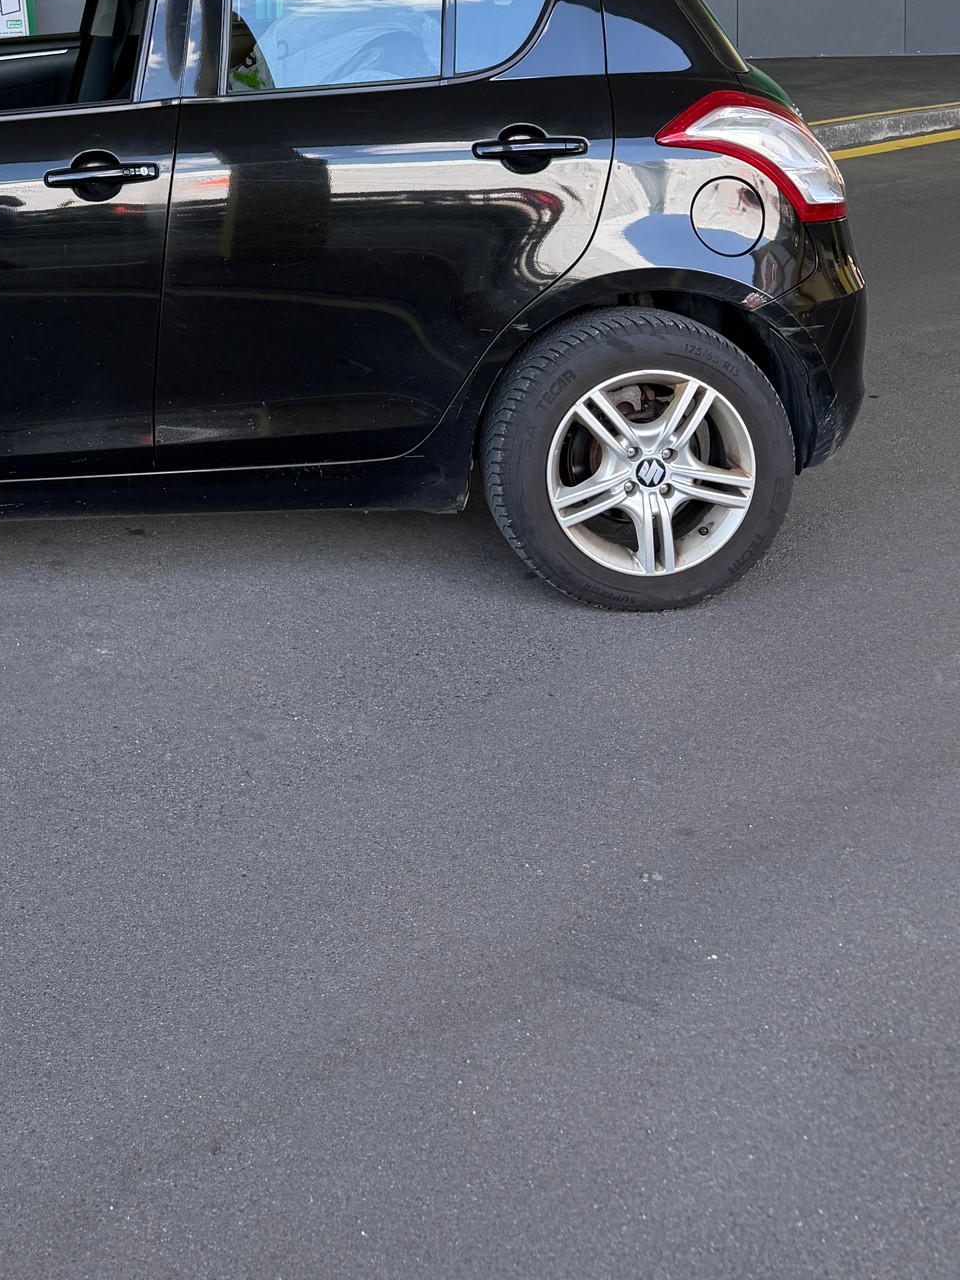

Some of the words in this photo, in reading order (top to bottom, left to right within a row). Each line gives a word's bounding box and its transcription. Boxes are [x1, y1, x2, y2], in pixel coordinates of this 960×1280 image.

[684, 343, 720, 364] 175/65
[722, 361, 741, 377] R15
[535, 368, 577, 411] TECAR
